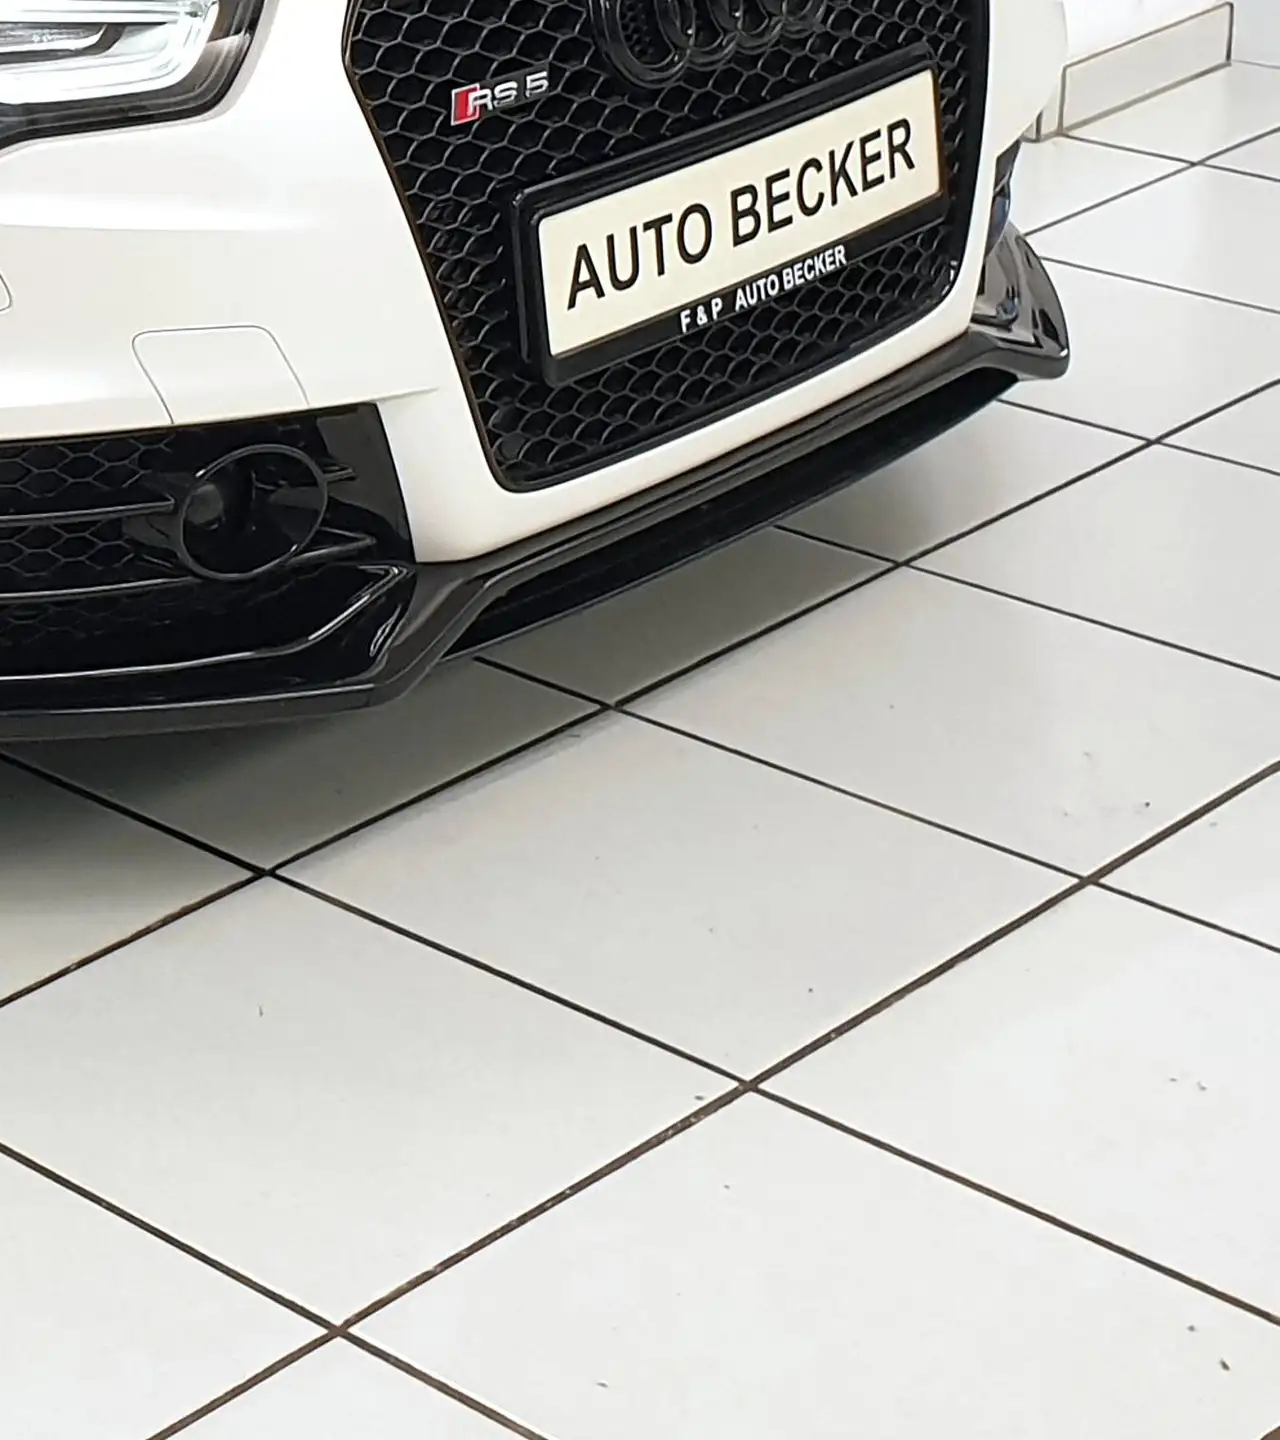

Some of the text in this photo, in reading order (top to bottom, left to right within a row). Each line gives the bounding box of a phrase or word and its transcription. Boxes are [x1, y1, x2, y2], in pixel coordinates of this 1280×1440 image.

[566, 118, 916, 311] AUTO BECKER
[734, 273, 780, 311] AUTO
[782, 244, 848, 291] BECKER
